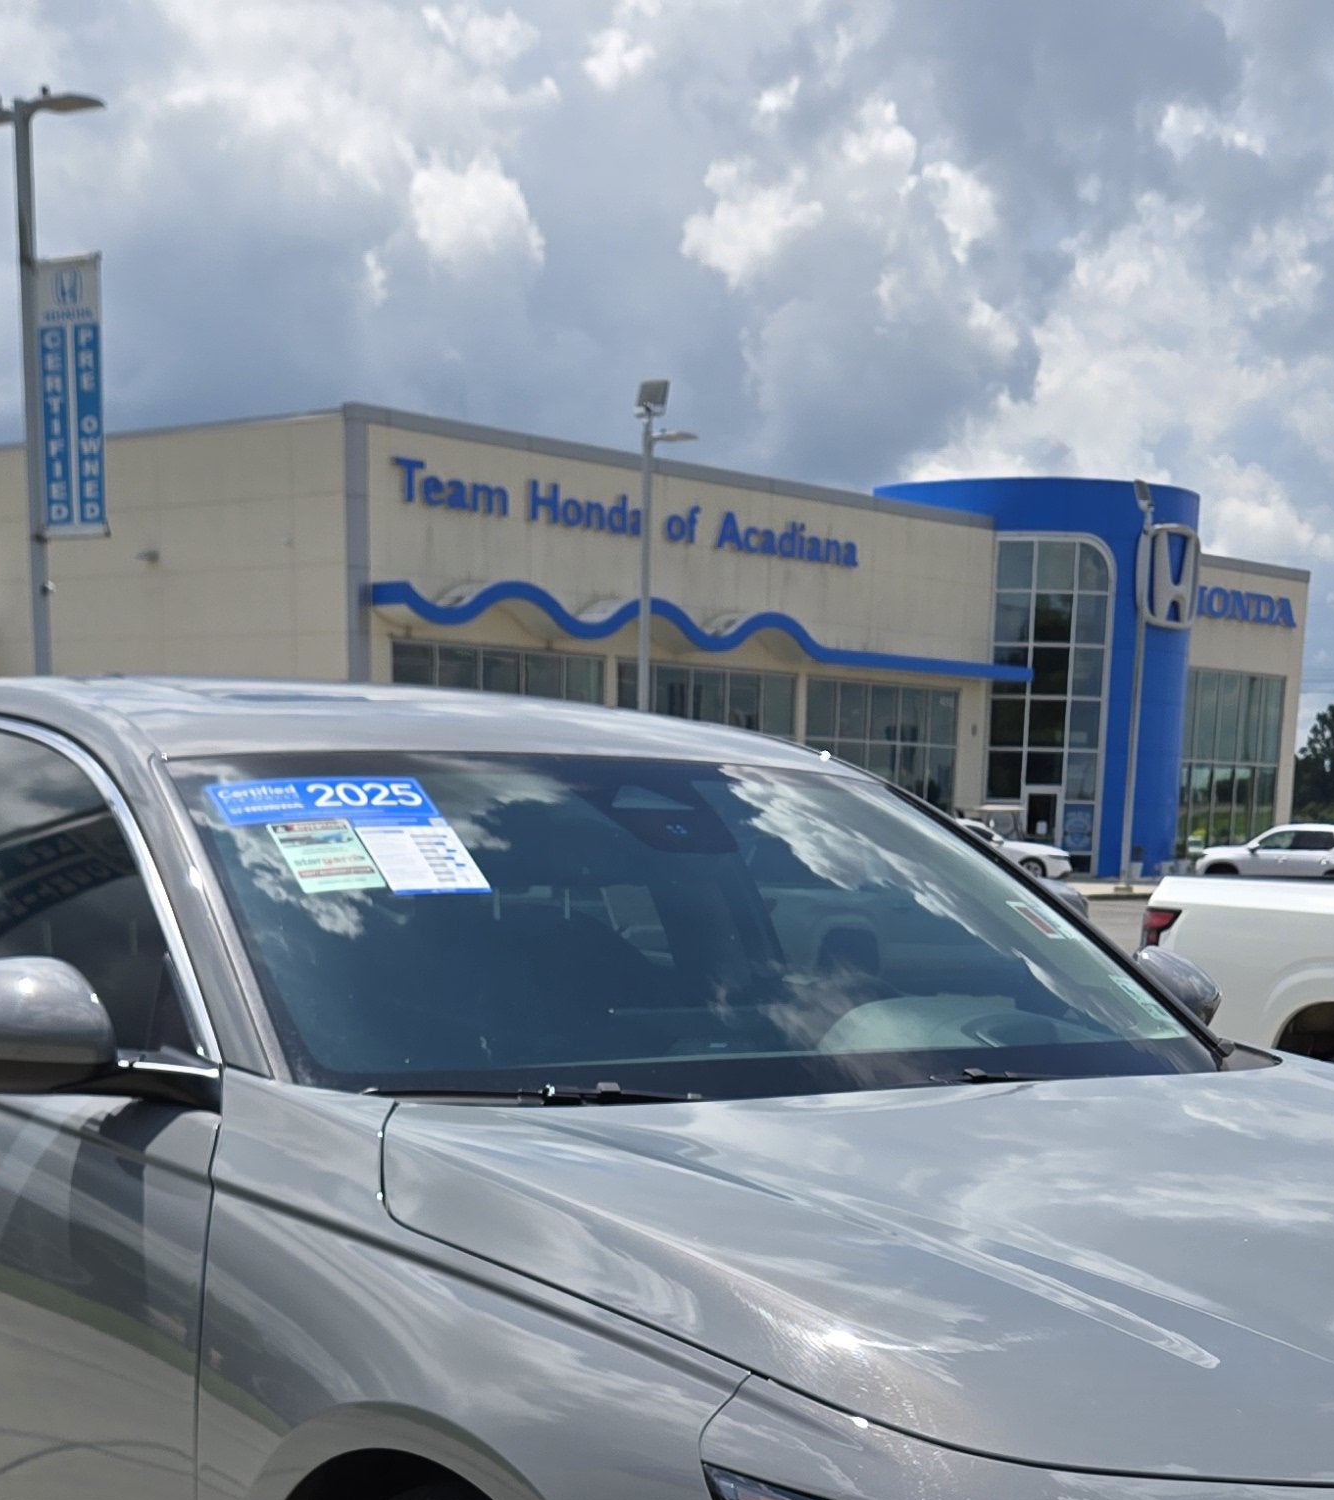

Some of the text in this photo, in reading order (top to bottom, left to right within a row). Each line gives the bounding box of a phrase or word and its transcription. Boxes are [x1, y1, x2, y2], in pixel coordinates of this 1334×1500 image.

[392, 456, 859, 568] Team Honda of Acadiana
[306, 783, 423, 807] 2025
